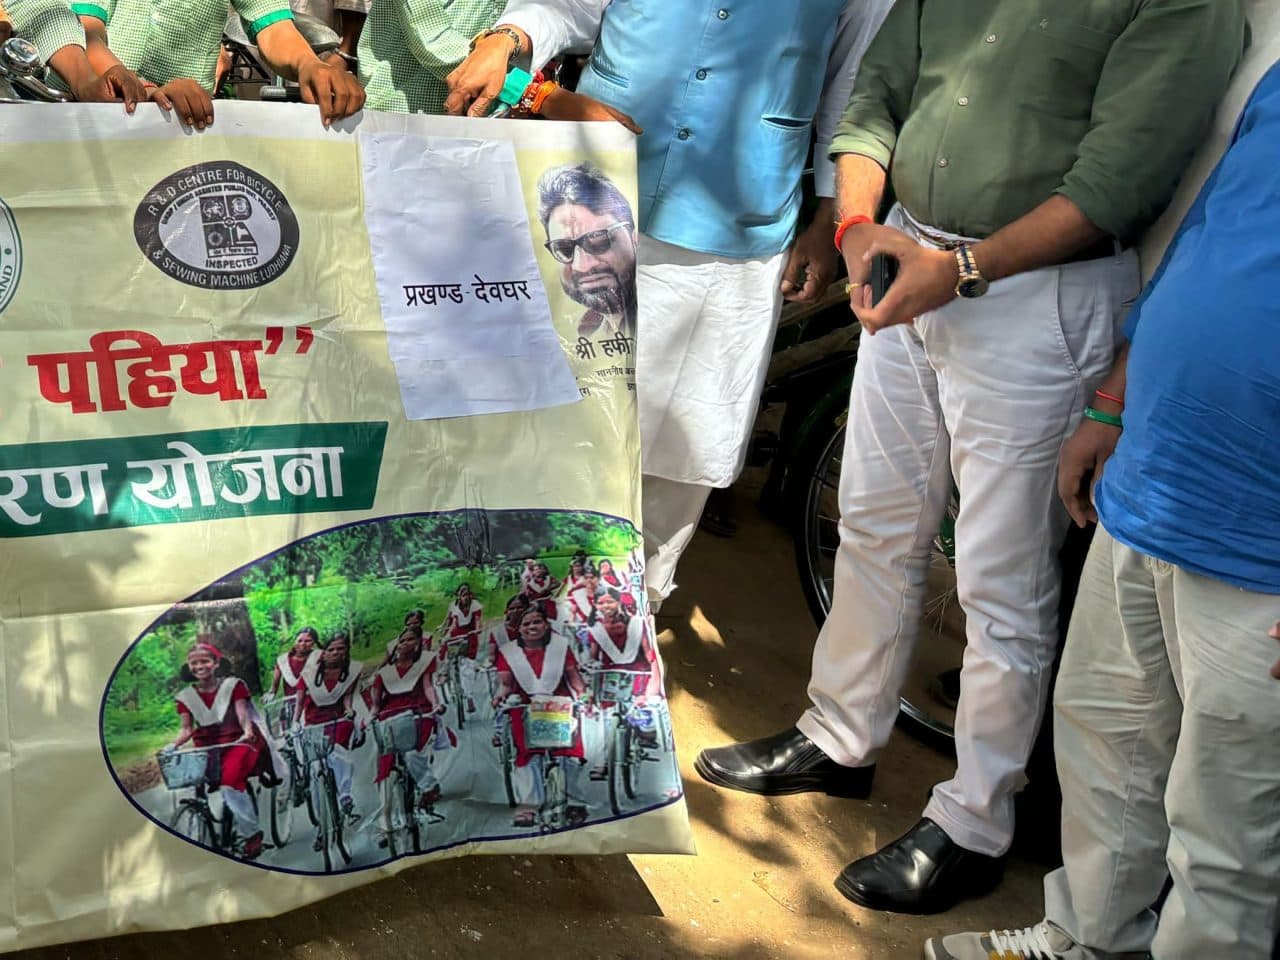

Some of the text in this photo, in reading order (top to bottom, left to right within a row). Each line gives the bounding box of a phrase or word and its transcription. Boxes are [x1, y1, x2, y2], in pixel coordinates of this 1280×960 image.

[148, 205, 159, 216] R
[167, 186, 177, 196] D
[178, 170, 223, 191] CENTRE
[226, 169, 245, 182] FOR
[247, 175, 283, 212] BICYCLE
[162, 258, 207, 285] SEWING
[210, 271, 259, 287] MACHINE
[259, 244, 292, 281] LUDHIANA
[205, 257, 258, 269] INSPECTED
[403, 282, 463, 307] प्रखण्ड
[471, 274, 531, 305] देवघर
[575, 331, 634, 359] श्री हफी
[128, 441, 344, 510] योजना
